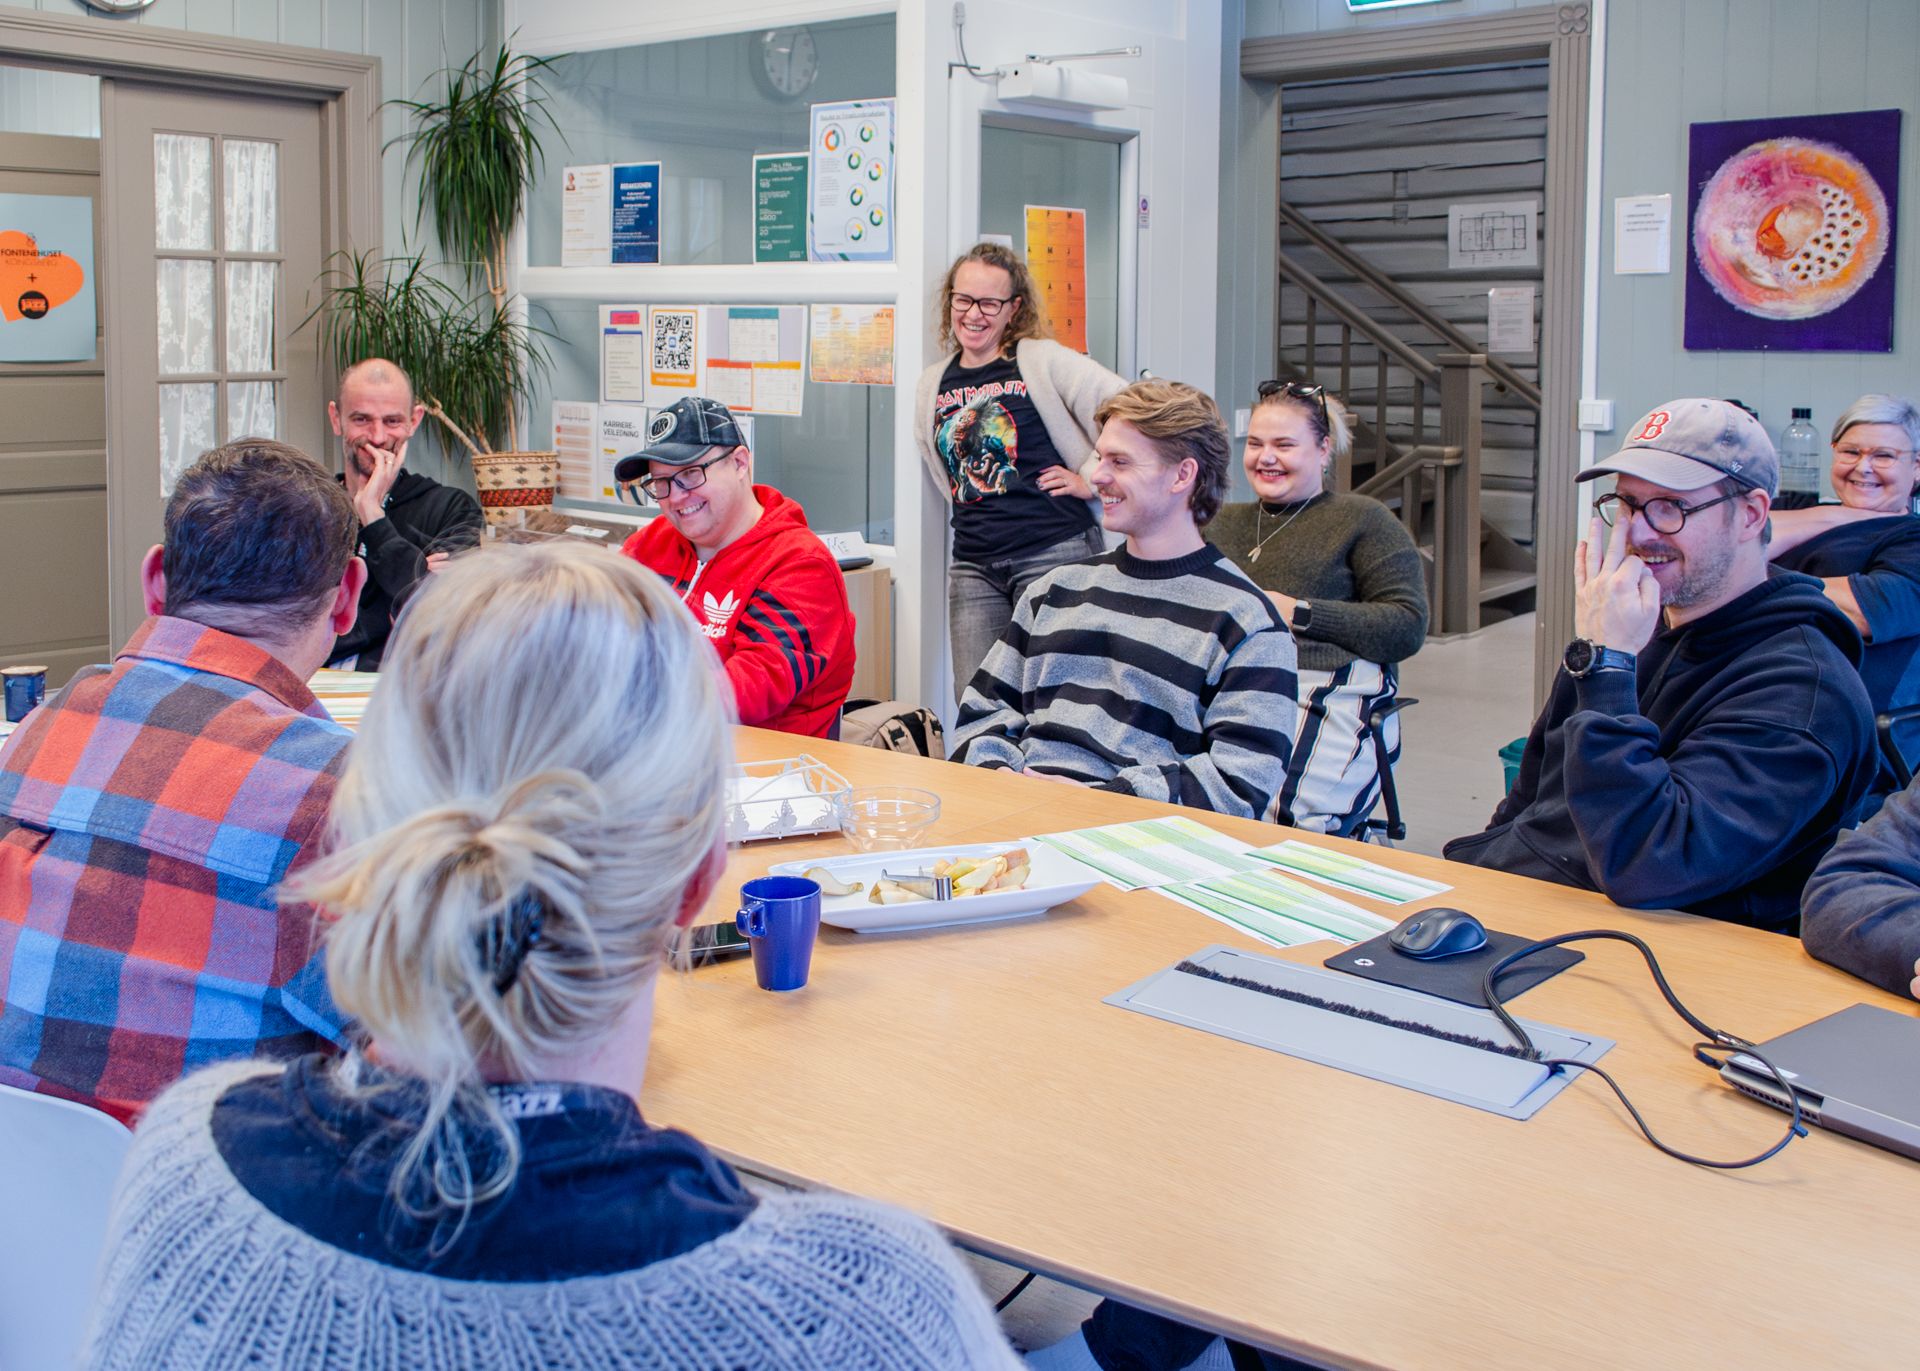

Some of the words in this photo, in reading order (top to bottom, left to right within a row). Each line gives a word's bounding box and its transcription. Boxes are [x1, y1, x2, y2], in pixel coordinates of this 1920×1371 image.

[937, 387, 964, 408] RON
[964, 379, 1027, 402] MAIDEN
[603, 420, 636, 429] KARRIERE-
[603, 428, 639, 438] VEILEDNING
[1634, 411, 1670, 441] B
